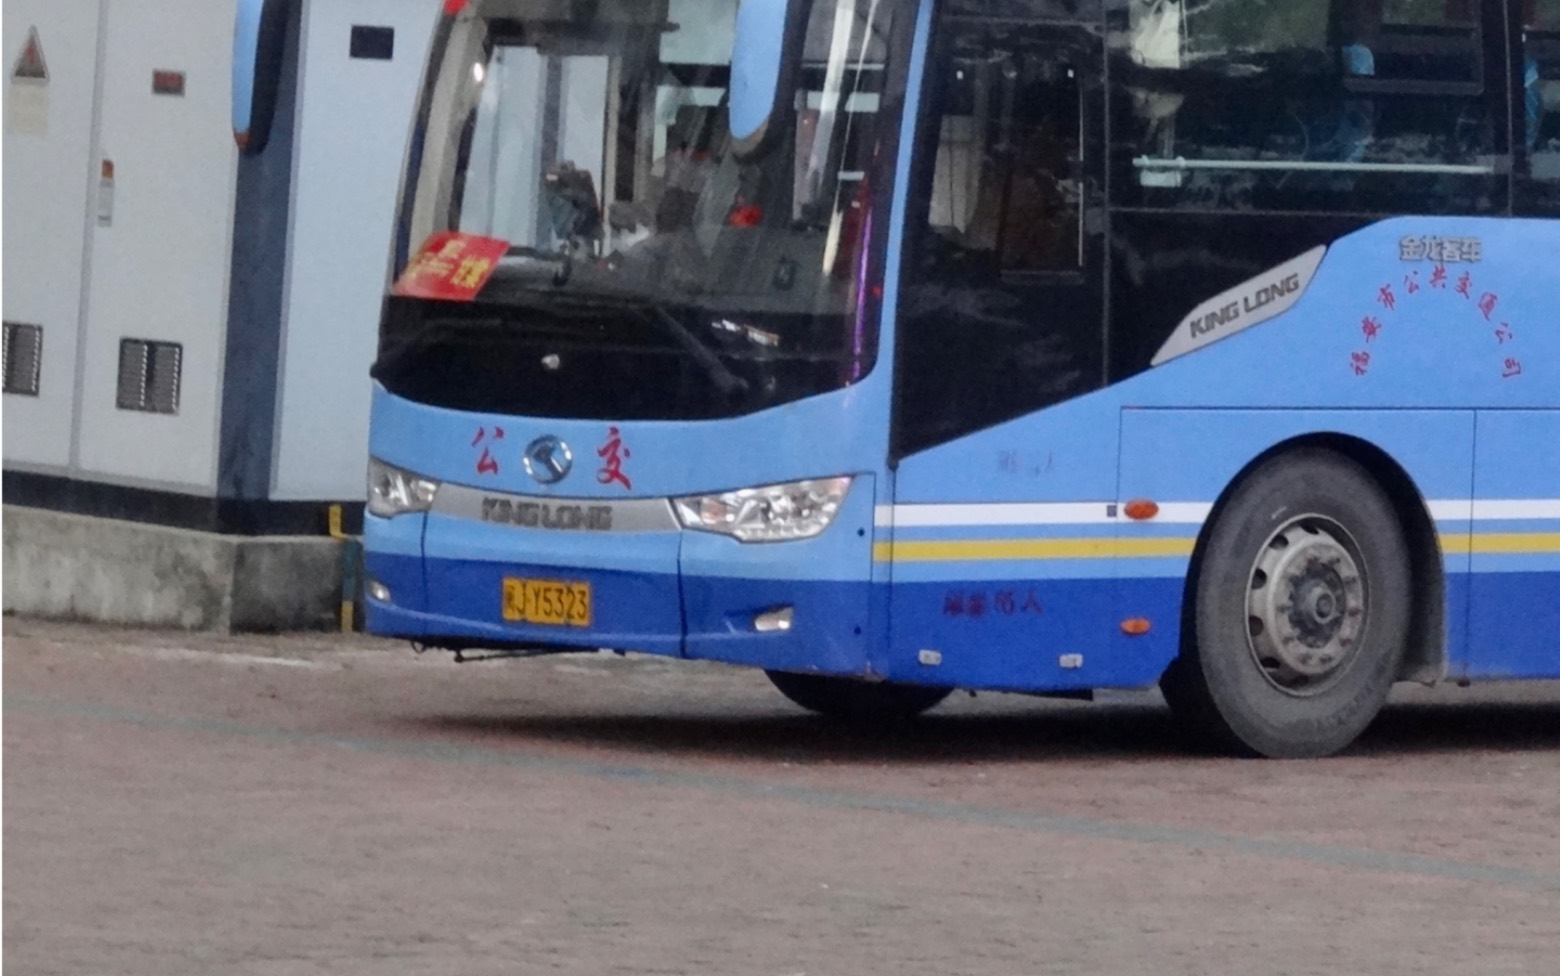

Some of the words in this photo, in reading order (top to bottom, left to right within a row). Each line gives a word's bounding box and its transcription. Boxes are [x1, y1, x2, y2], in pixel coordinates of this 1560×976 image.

[1399, 235, 1482, 262] 金龙客车
[1189, 301, 1239, 339] KING
[1243, 273, 1300, 313] LONG
